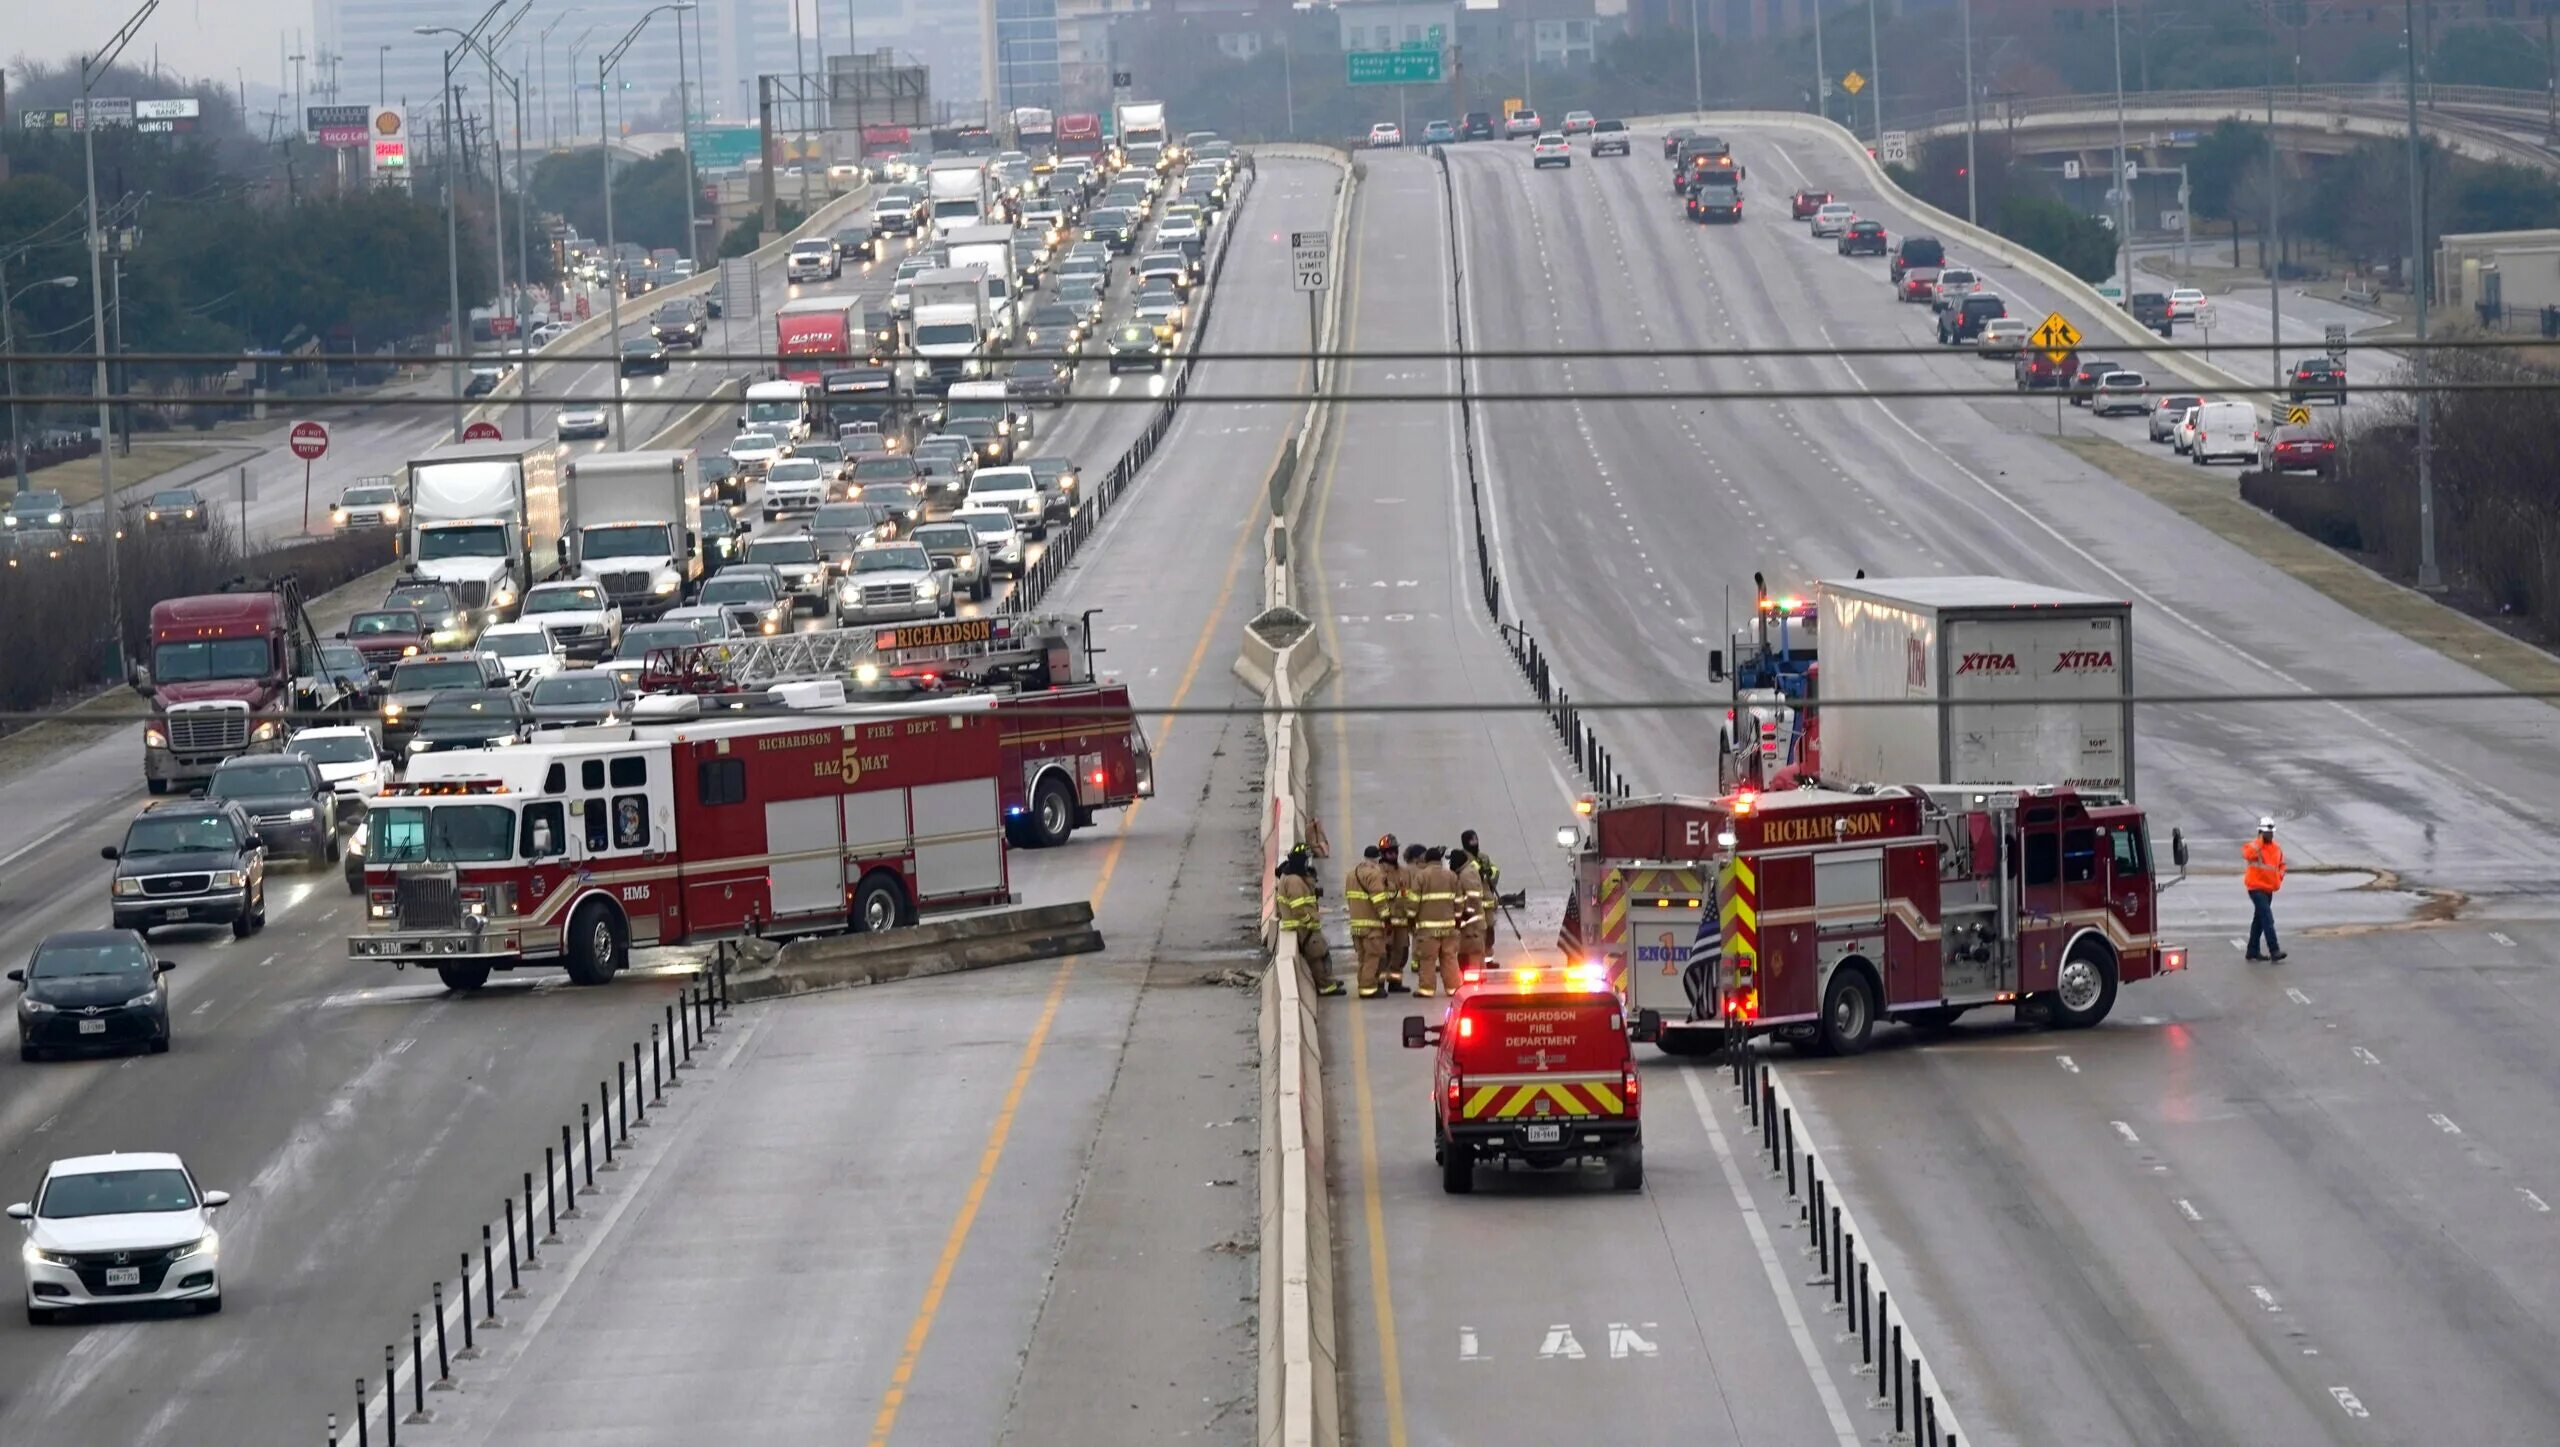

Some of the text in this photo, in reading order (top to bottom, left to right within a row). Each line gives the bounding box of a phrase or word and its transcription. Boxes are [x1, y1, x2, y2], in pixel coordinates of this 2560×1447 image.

[138, 121, 161, 132] KUNG
[162, 120, 173, 131] FU
[324, 132, 348, 141] TACO
[1888, 149, 1904, 158] 70
[1296, 250, 1326, 259] SPEED
[1299, 261, 1321, 270] LIMIT
[1300, 272, 1322, 286] 70
[299, 445, 319, 453] ENTER
[897, 620, 990, 647] RICHARDSON
[1956, 653, 2017, 674] XTRA
[2053, 650, 2113, 673] XTRA
[758, 721, 938, 751] RICHARDSON FIRE DEPT.
[814, 747, 889, 785] HAZ 5 MAT
[1686, 821, 1710, 846] E1
[1763, 812, 1882, 844] RICHARSON
[623, 885, 650, 900] HM5
[381, 942, 434, 955] HM 5
[1659, 932, 1678, 976] 1
[1505, 1011, 1577, 1022] RICHARDSON
[1529, 1024, 1553, 1034] FIRE
[1505, 1036, 1577, 1047] DEPARTMENT
[1536, 1049, 1549, 1071] 1
